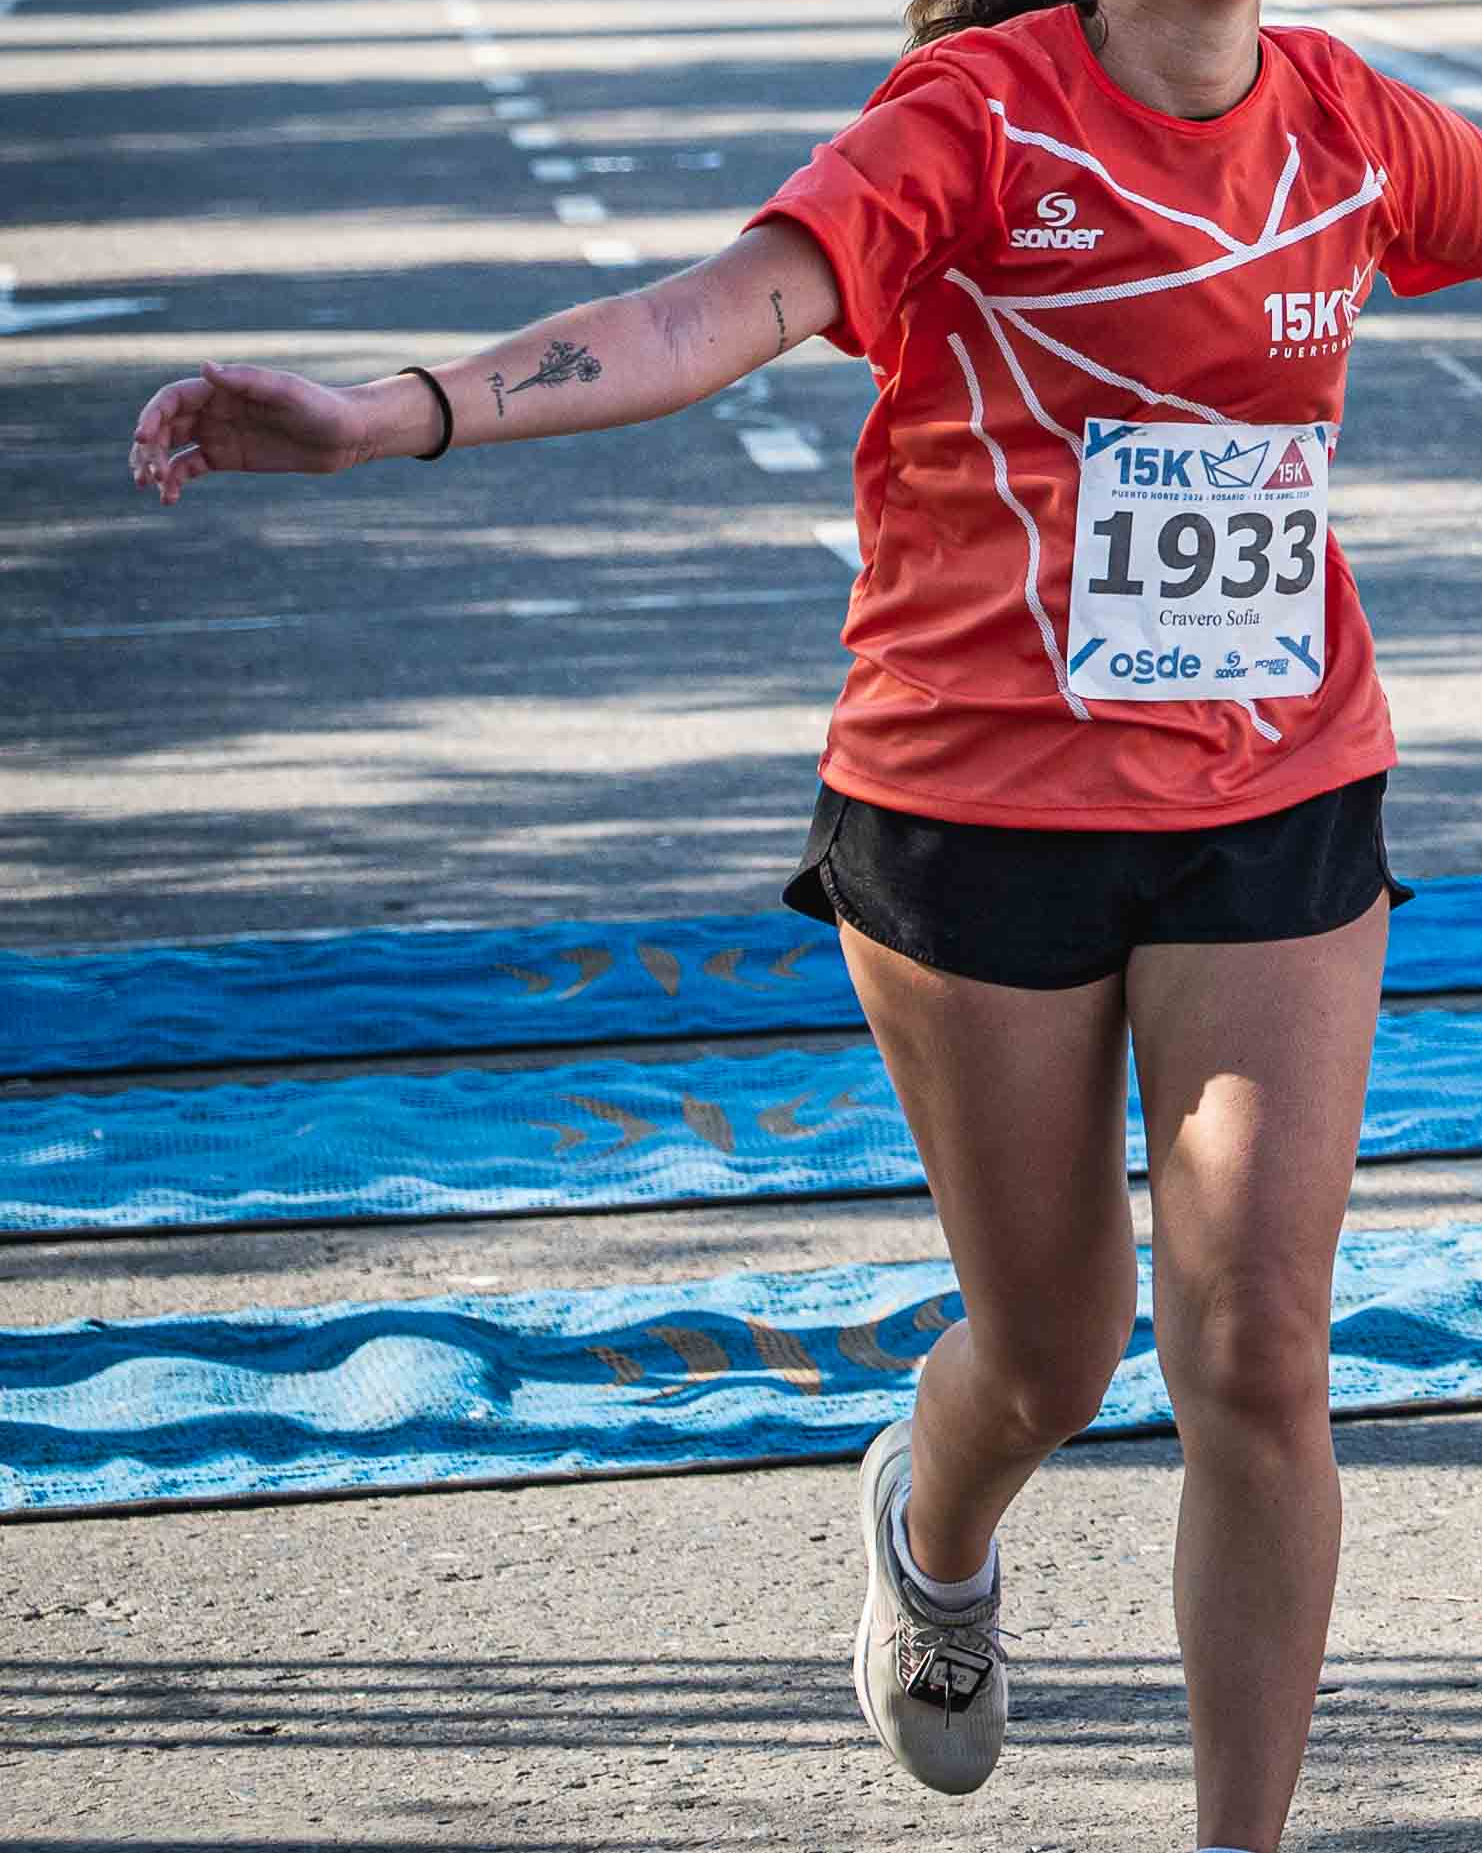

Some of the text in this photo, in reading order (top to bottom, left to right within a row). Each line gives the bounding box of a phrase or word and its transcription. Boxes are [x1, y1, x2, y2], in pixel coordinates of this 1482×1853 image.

[1264, 291, 1345, 342] 15K
[1269, 341, 1339, 359] PUERTO
[1114, 446, 1195, 488] 15K
[1278, 460, 1306, 484] 15K
[1111, 489, 1148, 499] PUERTO
[1088, 508, 1317, 599] 1933
[1159, 609, 1223, 627] Cravero
[1109, 645, 1202, 685] osde
